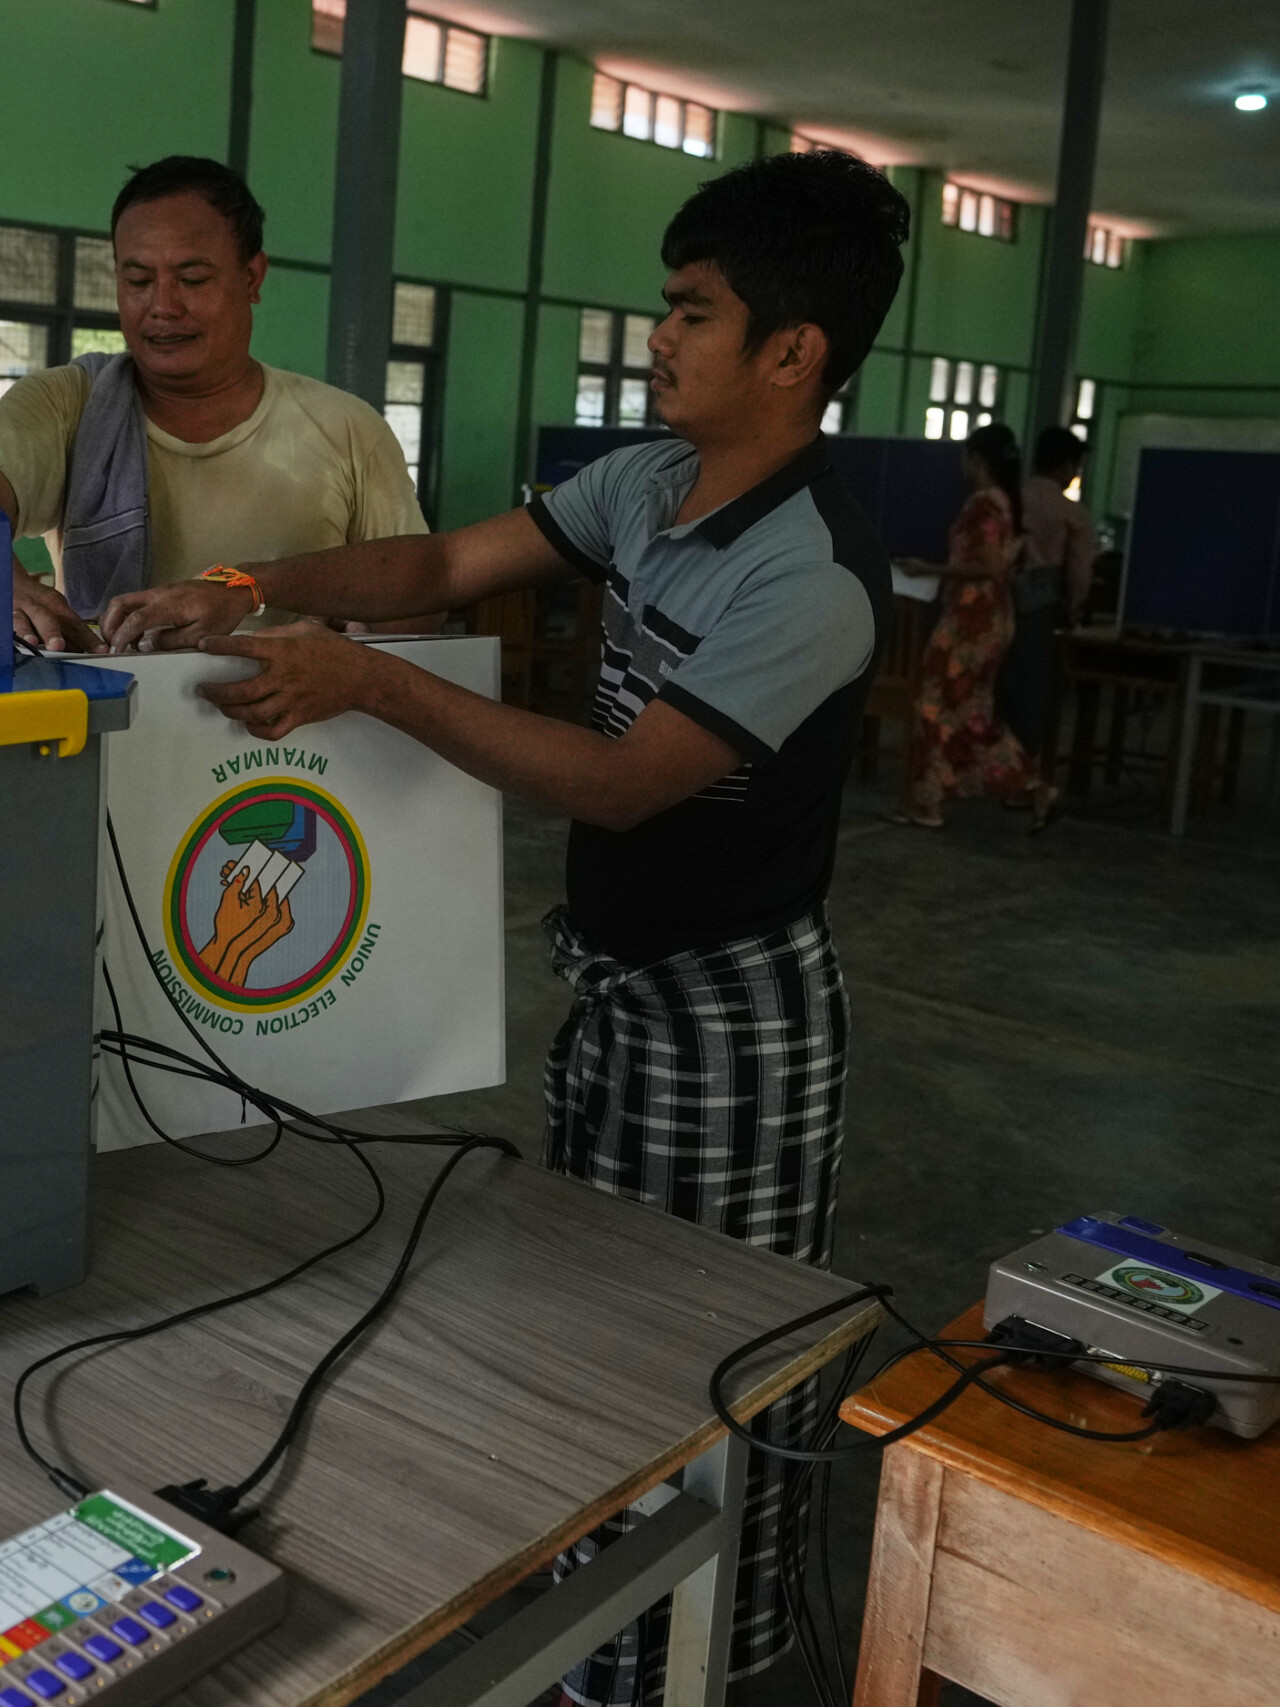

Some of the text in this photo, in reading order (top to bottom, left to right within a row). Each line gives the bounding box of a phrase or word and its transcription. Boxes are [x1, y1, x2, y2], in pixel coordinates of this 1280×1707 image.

[211, 747, 329, 784] MYANMAR
[152, 923, 382, 1036] UNION ELECTION COMMISSION
